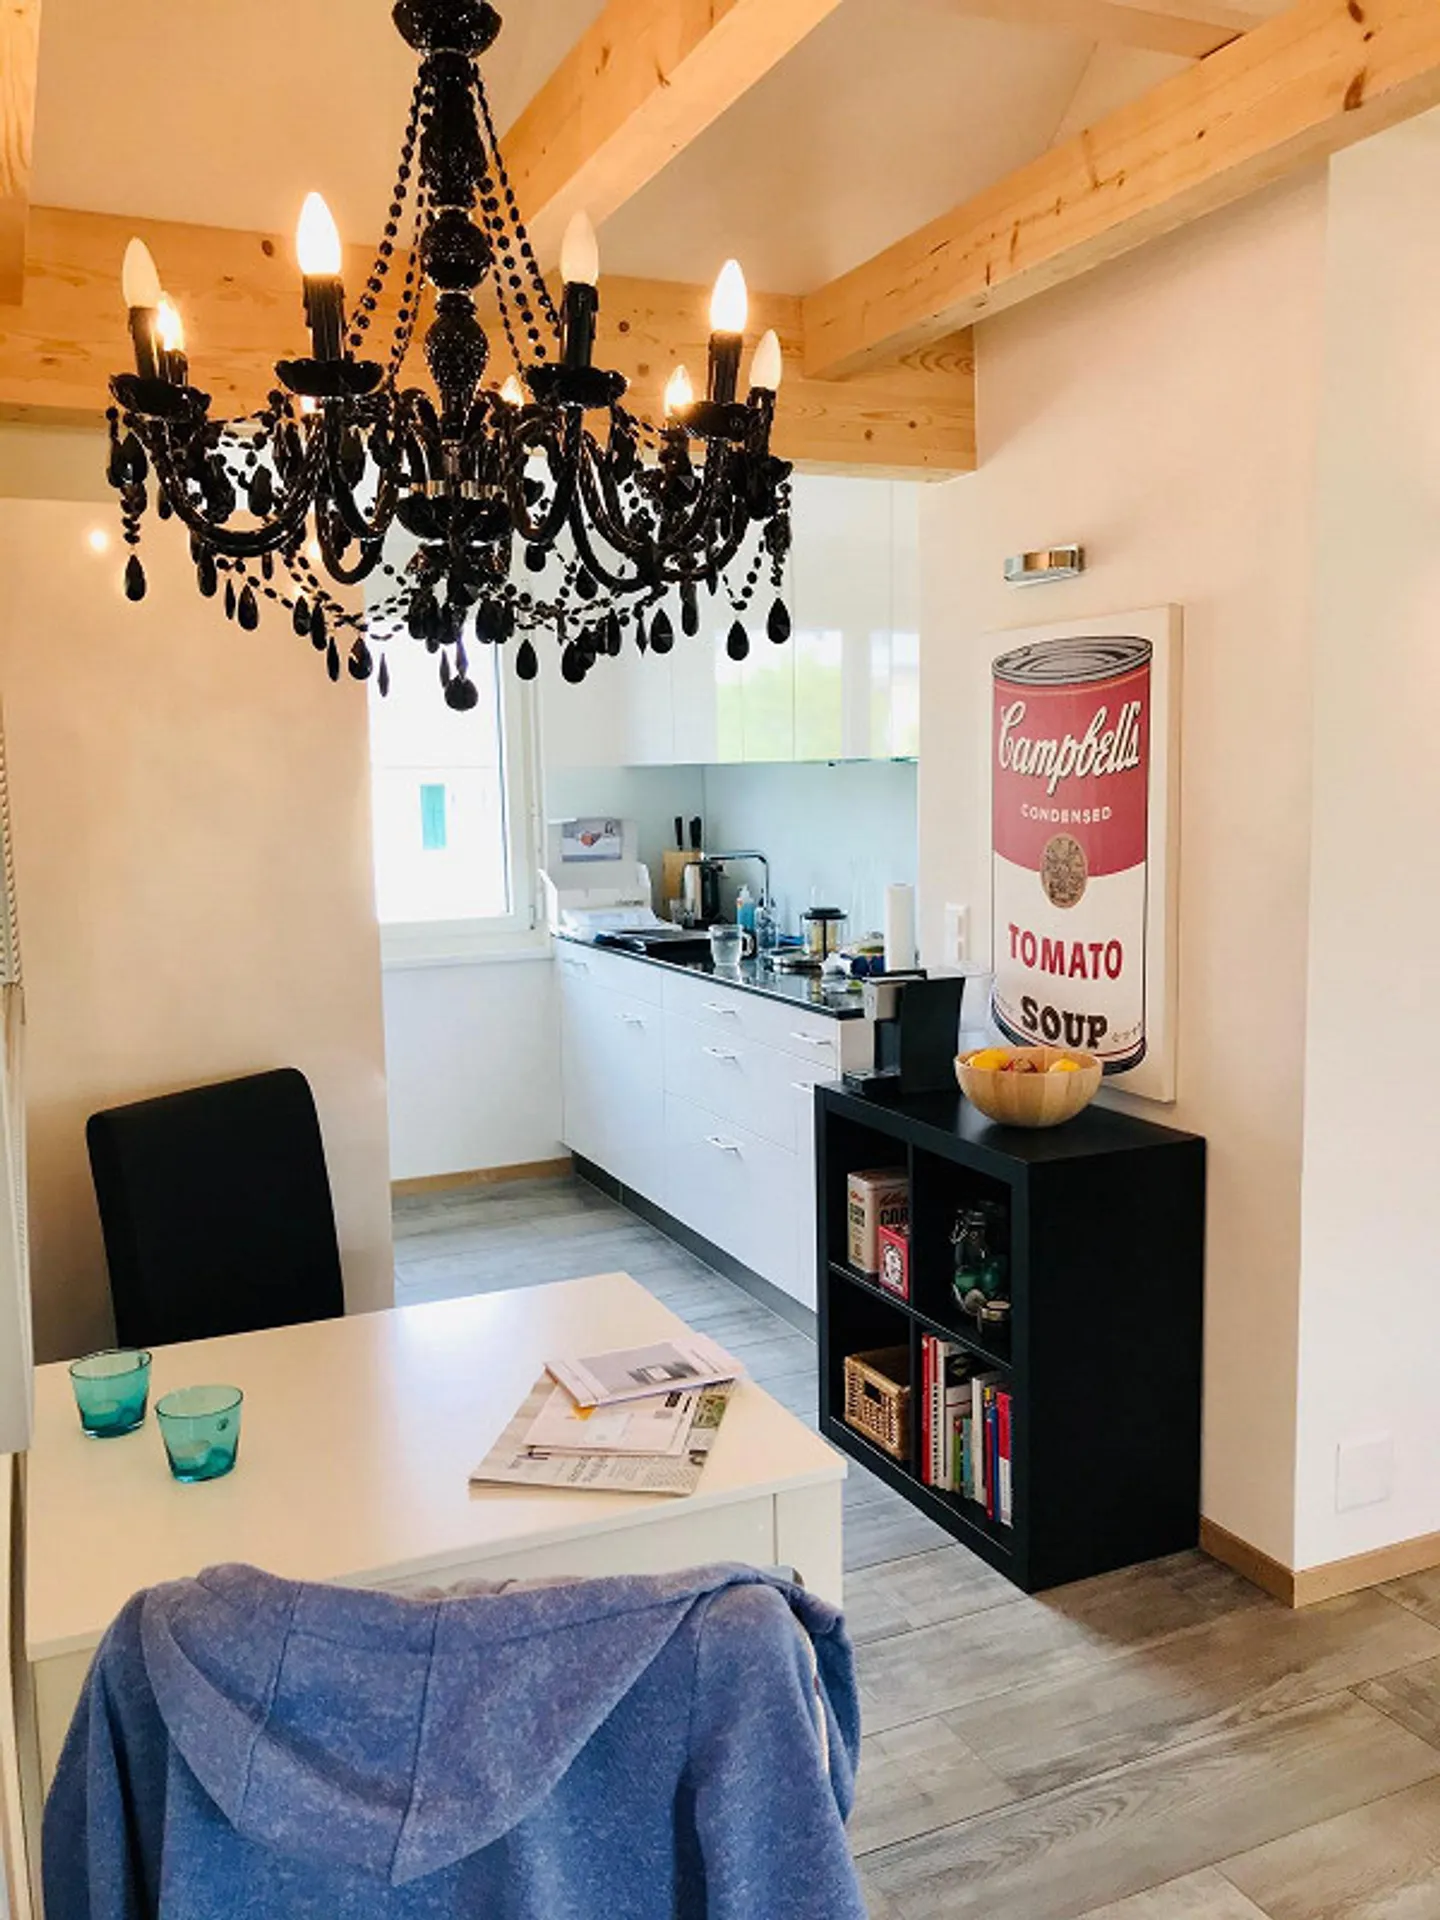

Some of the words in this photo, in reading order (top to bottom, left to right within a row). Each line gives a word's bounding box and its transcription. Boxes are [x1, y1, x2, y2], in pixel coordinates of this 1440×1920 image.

[1020, 803, 1113, 824] CONDENSED
[1008, 922, 1124, 980] TOMATO
[1020, 995, 1109, 1050] SOUP
